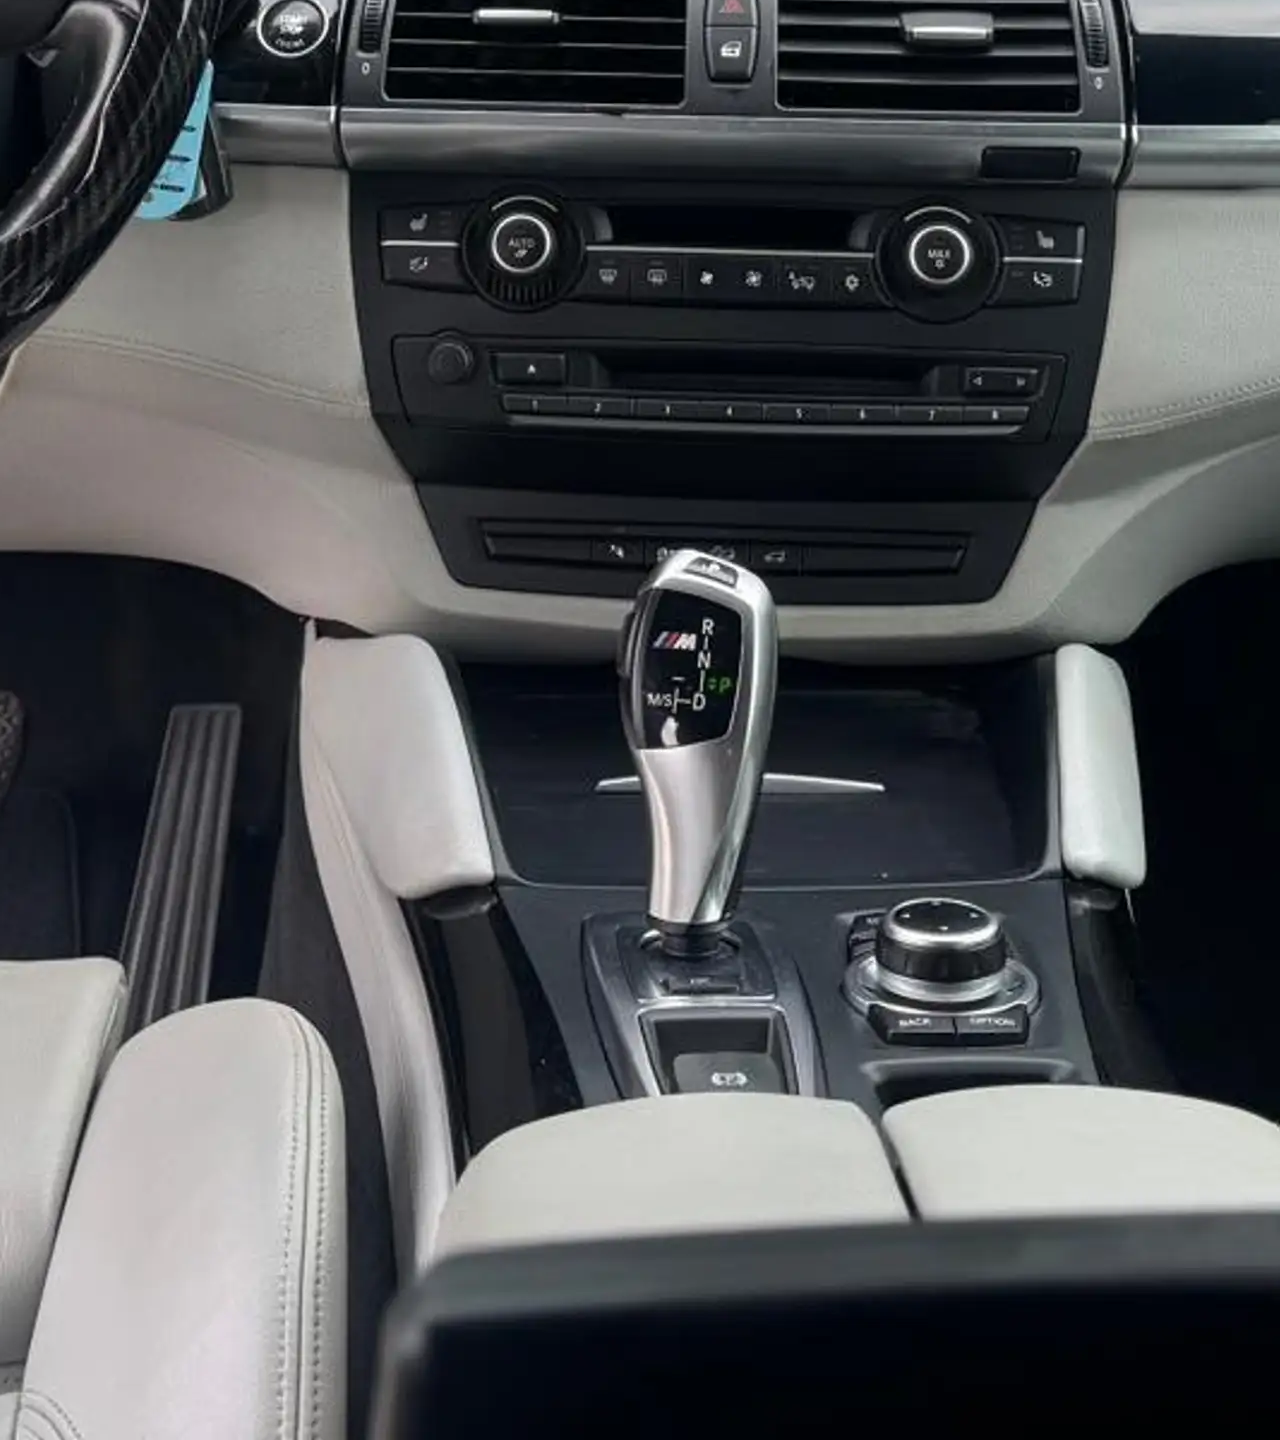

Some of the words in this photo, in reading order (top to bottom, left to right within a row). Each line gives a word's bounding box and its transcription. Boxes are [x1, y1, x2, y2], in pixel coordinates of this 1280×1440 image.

[508, 237, 535, 249] AUTO
[702, 618, 715, 635] R
[697, 652, 711, 669] N
[719, 678, 732, 693] P
[647, 693, 672, 707] M/S
[692, 693, 706, 710] D
[898, 1017, 932, 1027] BACK
[969, 1017, 1017, 1027] OPTION
